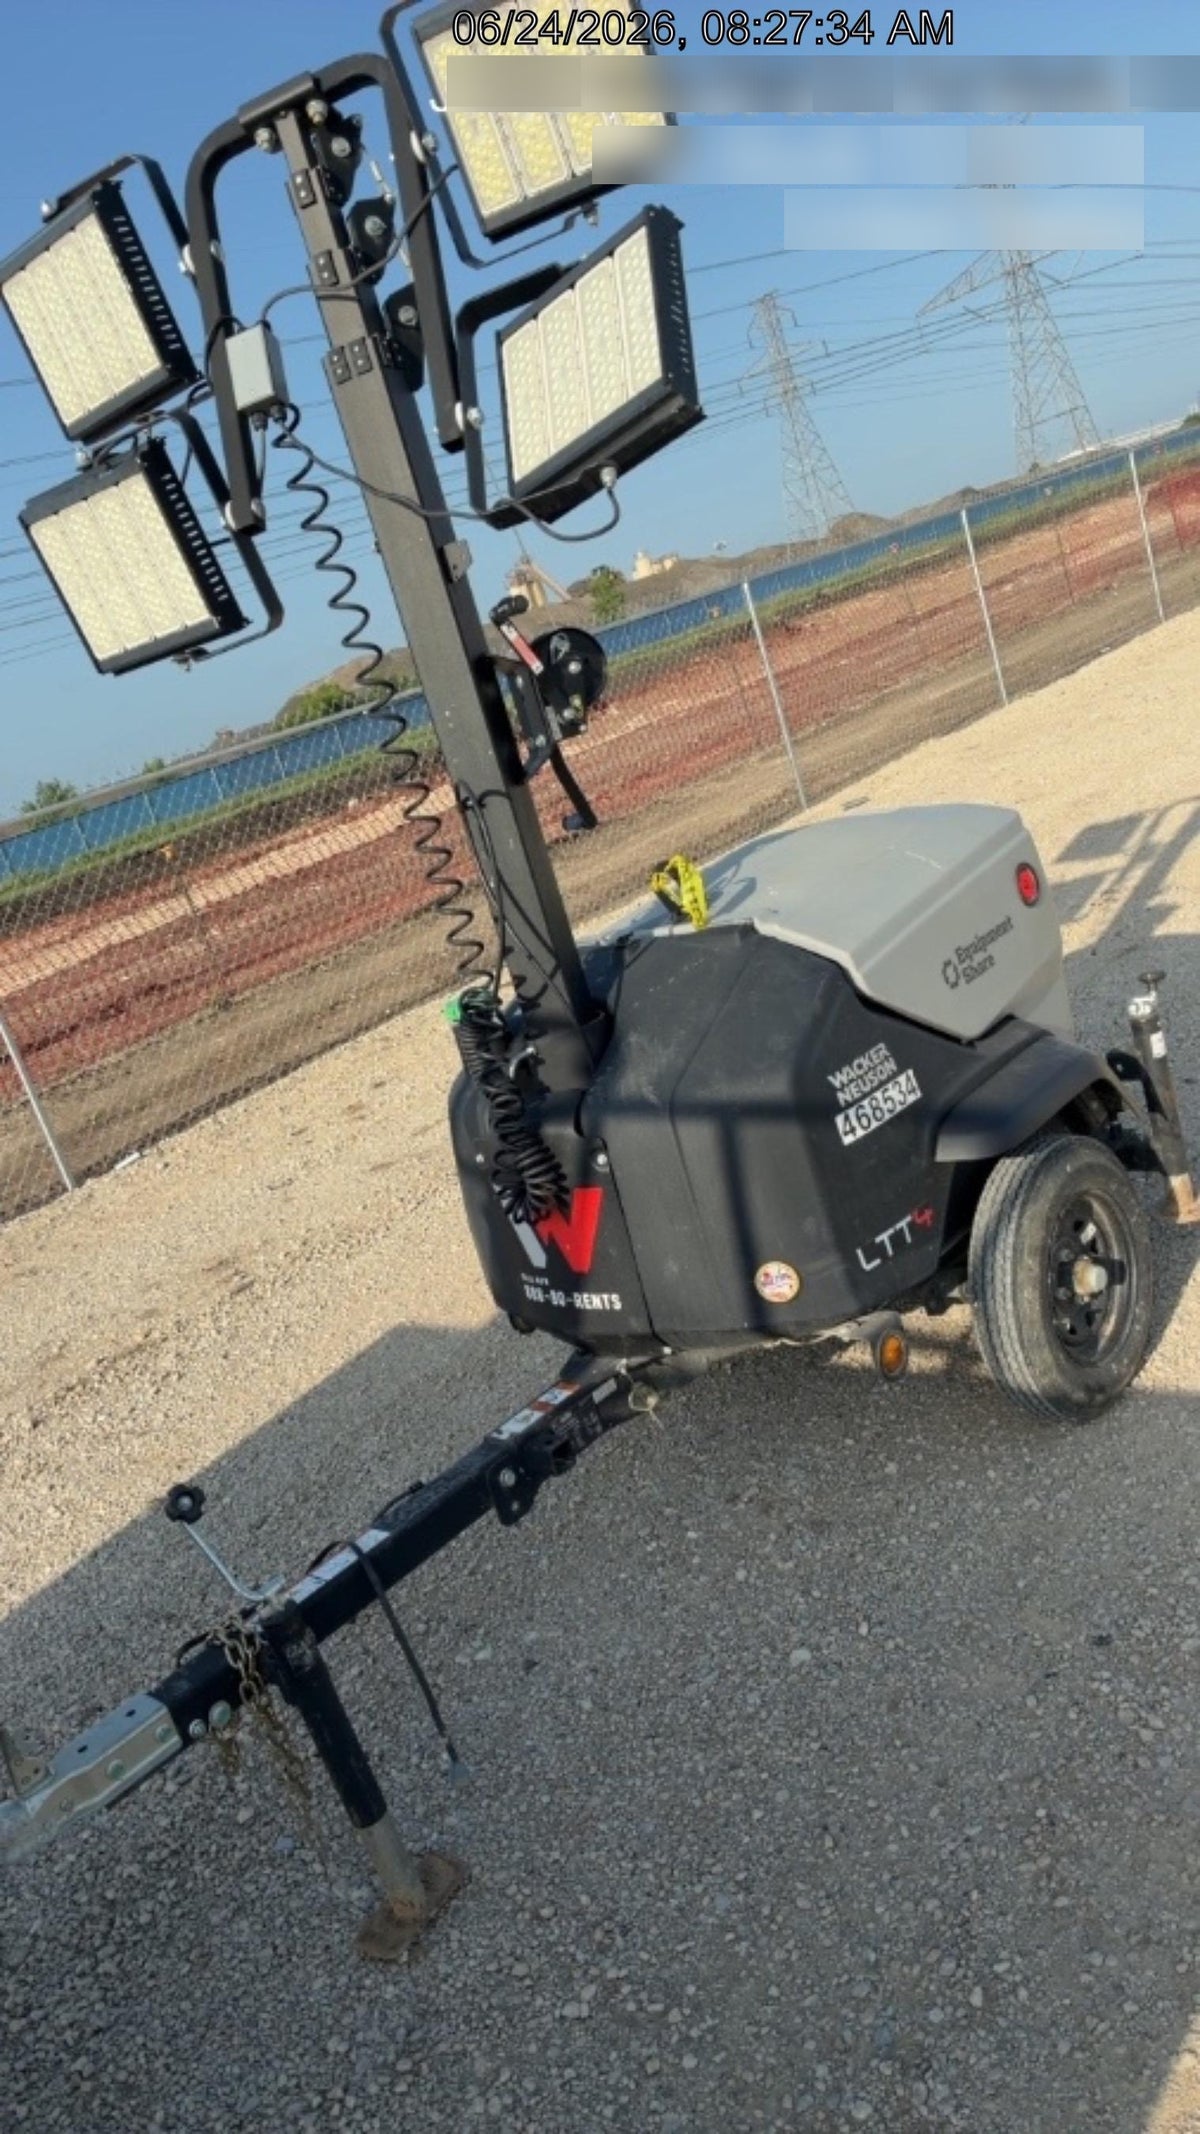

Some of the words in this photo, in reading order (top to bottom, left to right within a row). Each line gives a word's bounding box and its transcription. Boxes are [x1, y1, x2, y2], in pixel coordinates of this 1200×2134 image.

[955, 914, 1013, 965] Equipment
[962, 953, 995, 984] Share
[827, 1042, 891, 1089] WACKER
[837, 1056, 898, 1107] NEUSON
[842, 1072, 919, 1137] 468534
